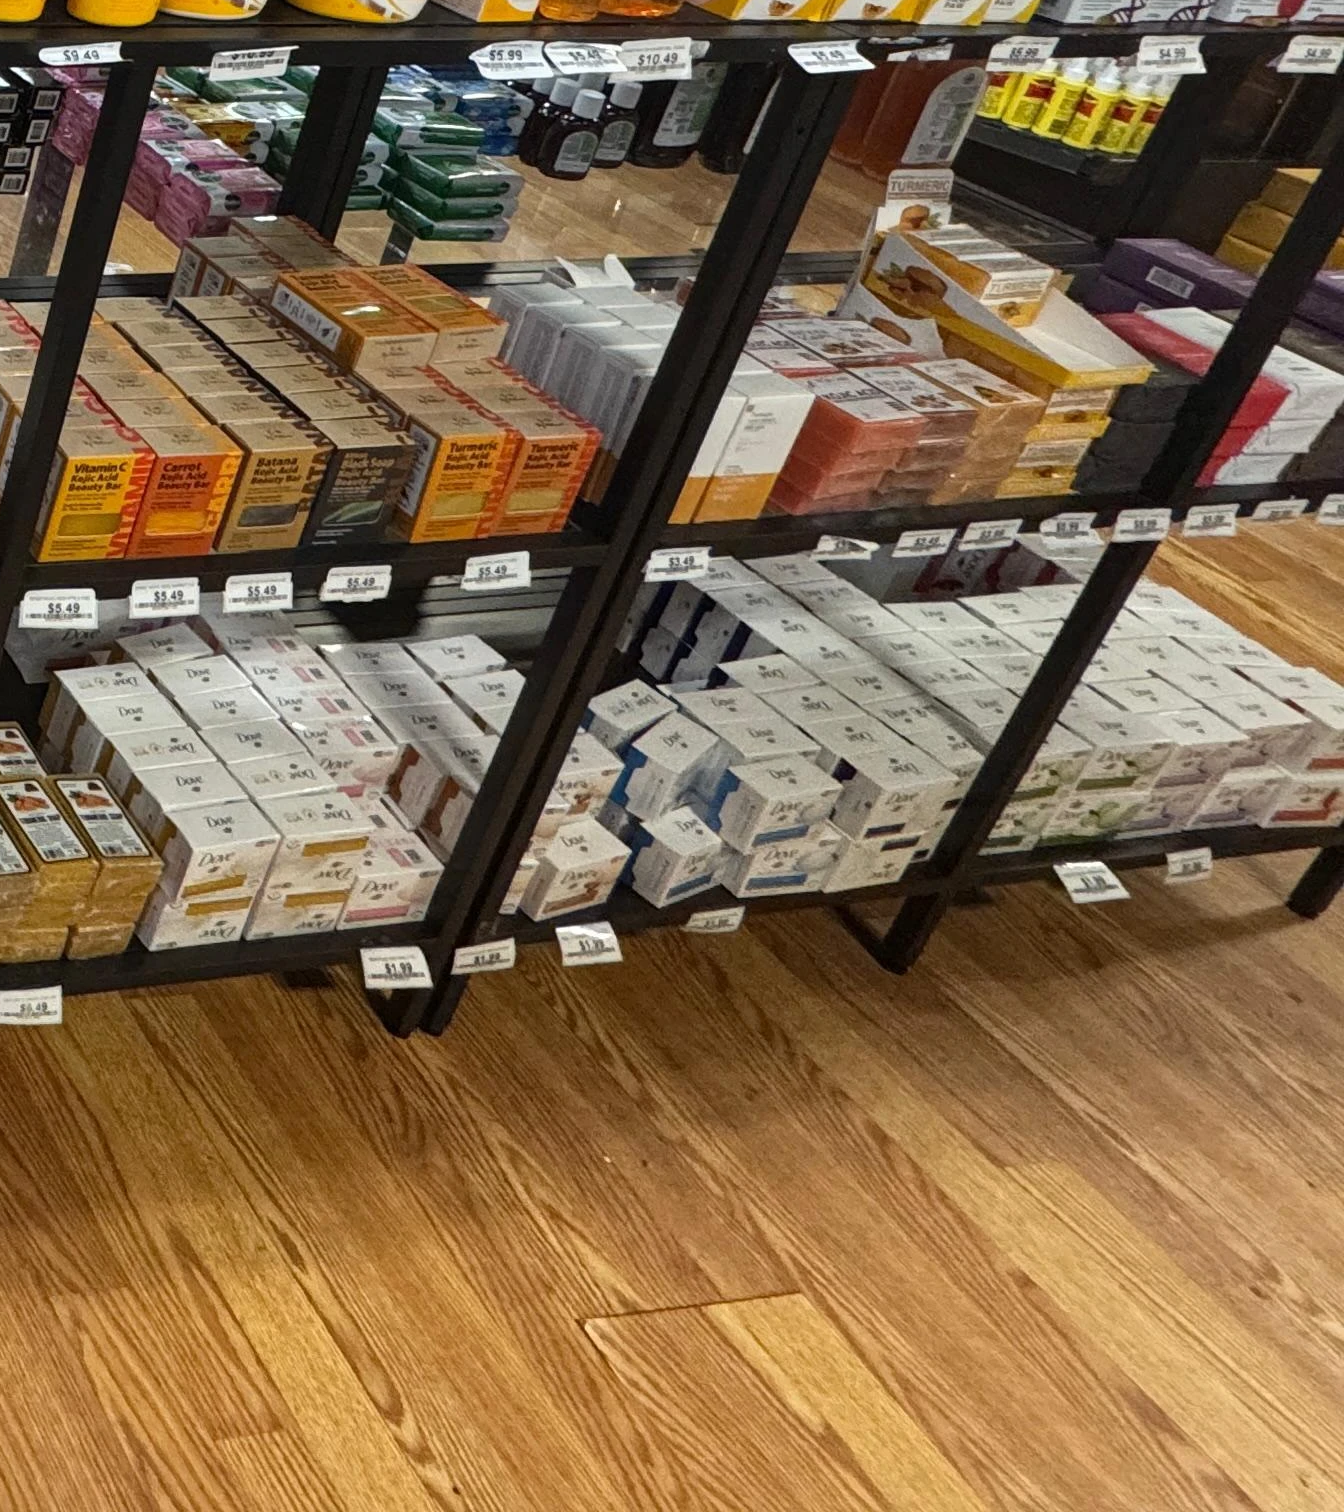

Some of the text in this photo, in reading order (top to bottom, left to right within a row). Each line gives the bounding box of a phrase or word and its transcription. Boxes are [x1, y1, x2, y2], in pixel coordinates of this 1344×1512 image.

[636, 51, 679, 68] $10.49
[450, 442, 498, 452] Turmeric
[163, 462, 202, 472] Carrot
[257, 456, 298, 467] Batana
[74, 462, 128, 475] Vitamin C
[104, 481, 123, 490] Bar
[668, 556, 695, 567] $3.49
[47, 602, 80, 614] $5.49
[206, 815, 235, 830] Dove
